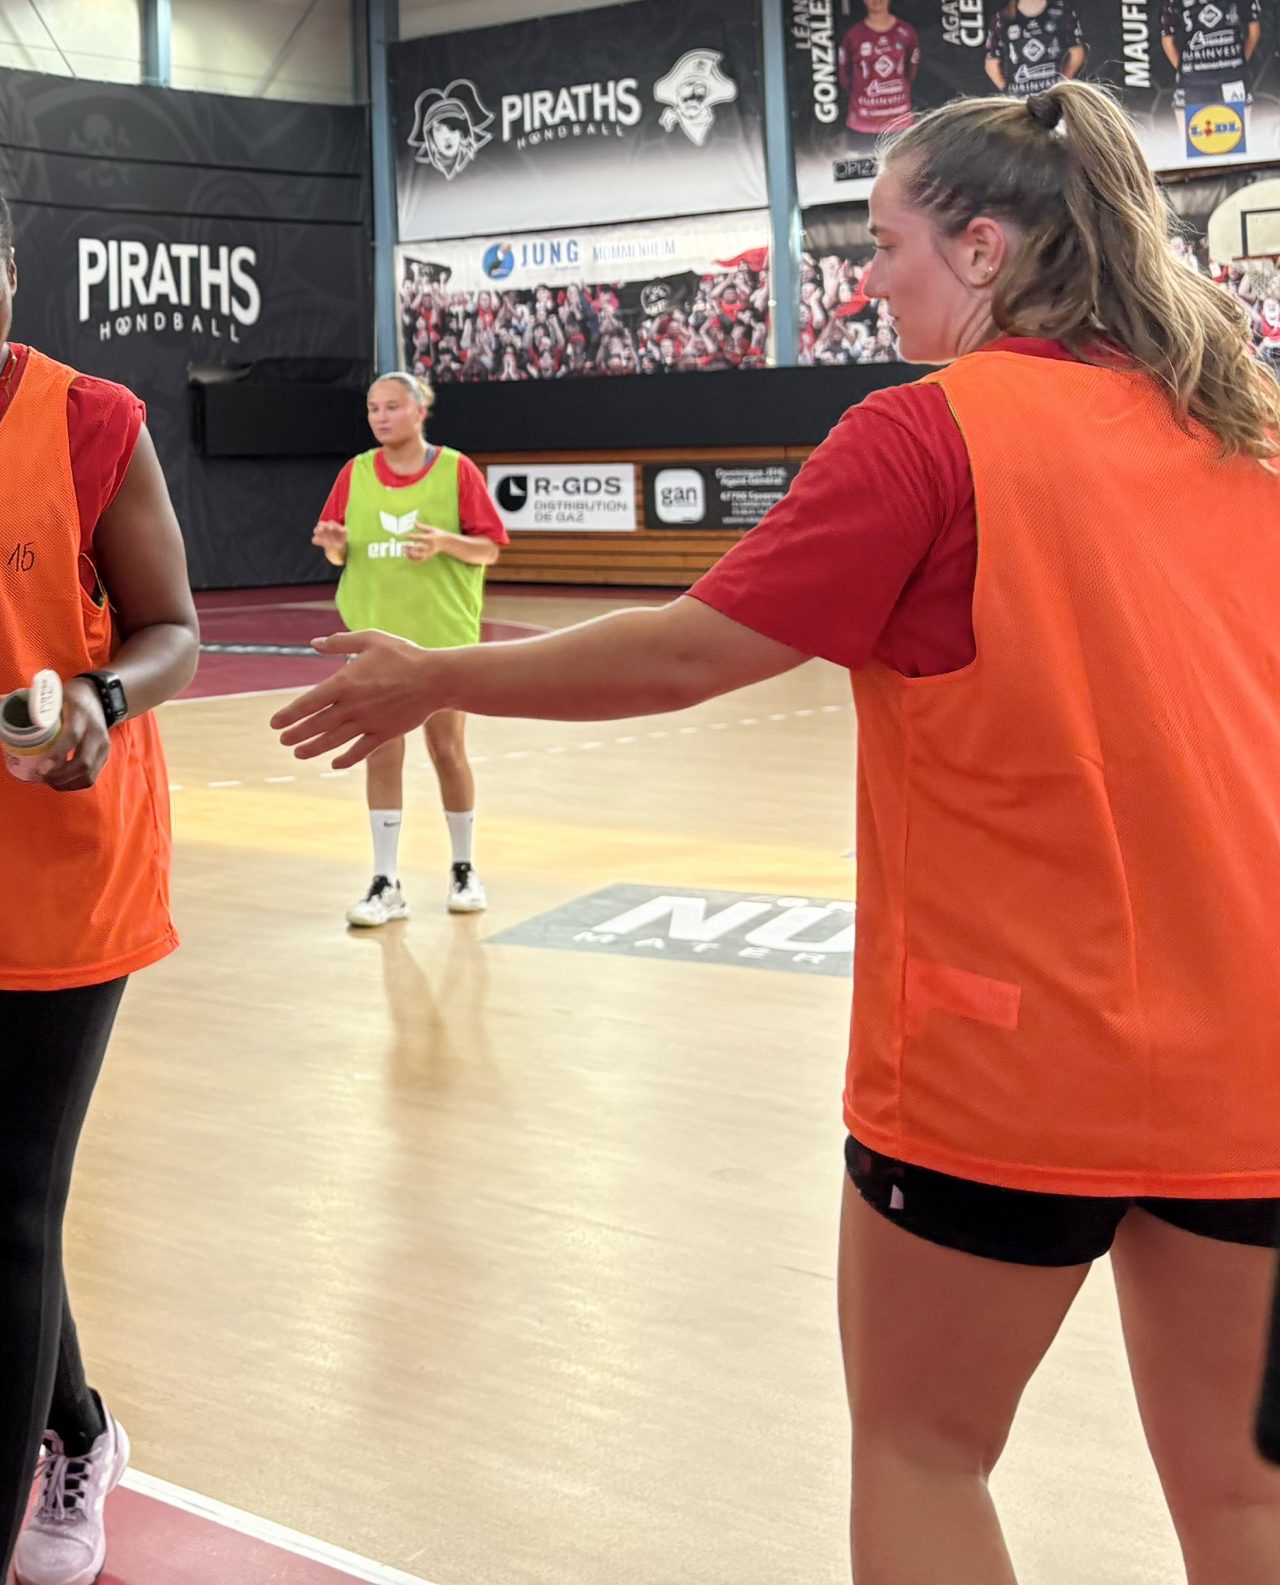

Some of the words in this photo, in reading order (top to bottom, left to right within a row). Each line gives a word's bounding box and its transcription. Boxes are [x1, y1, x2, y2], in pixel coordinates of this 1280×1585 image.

[1121, 0, 1149, 88] MAUF
[809, 0, 838, 123] GONZALE
[502, 78, 641, 142] PIRATHS
[1190, 120, 1240, 138] LIDL
[522, 239, 579, 267] JUNG
[78, 238, 261, 326] PIRATHS
[534, 476, 622, 496] R-GDS
[661, 486, 698, 508] gan
[534, 511, 552, 524] DE
[556, 511, 584, 524] GAZ
[7, 541, 36, 573] 15
